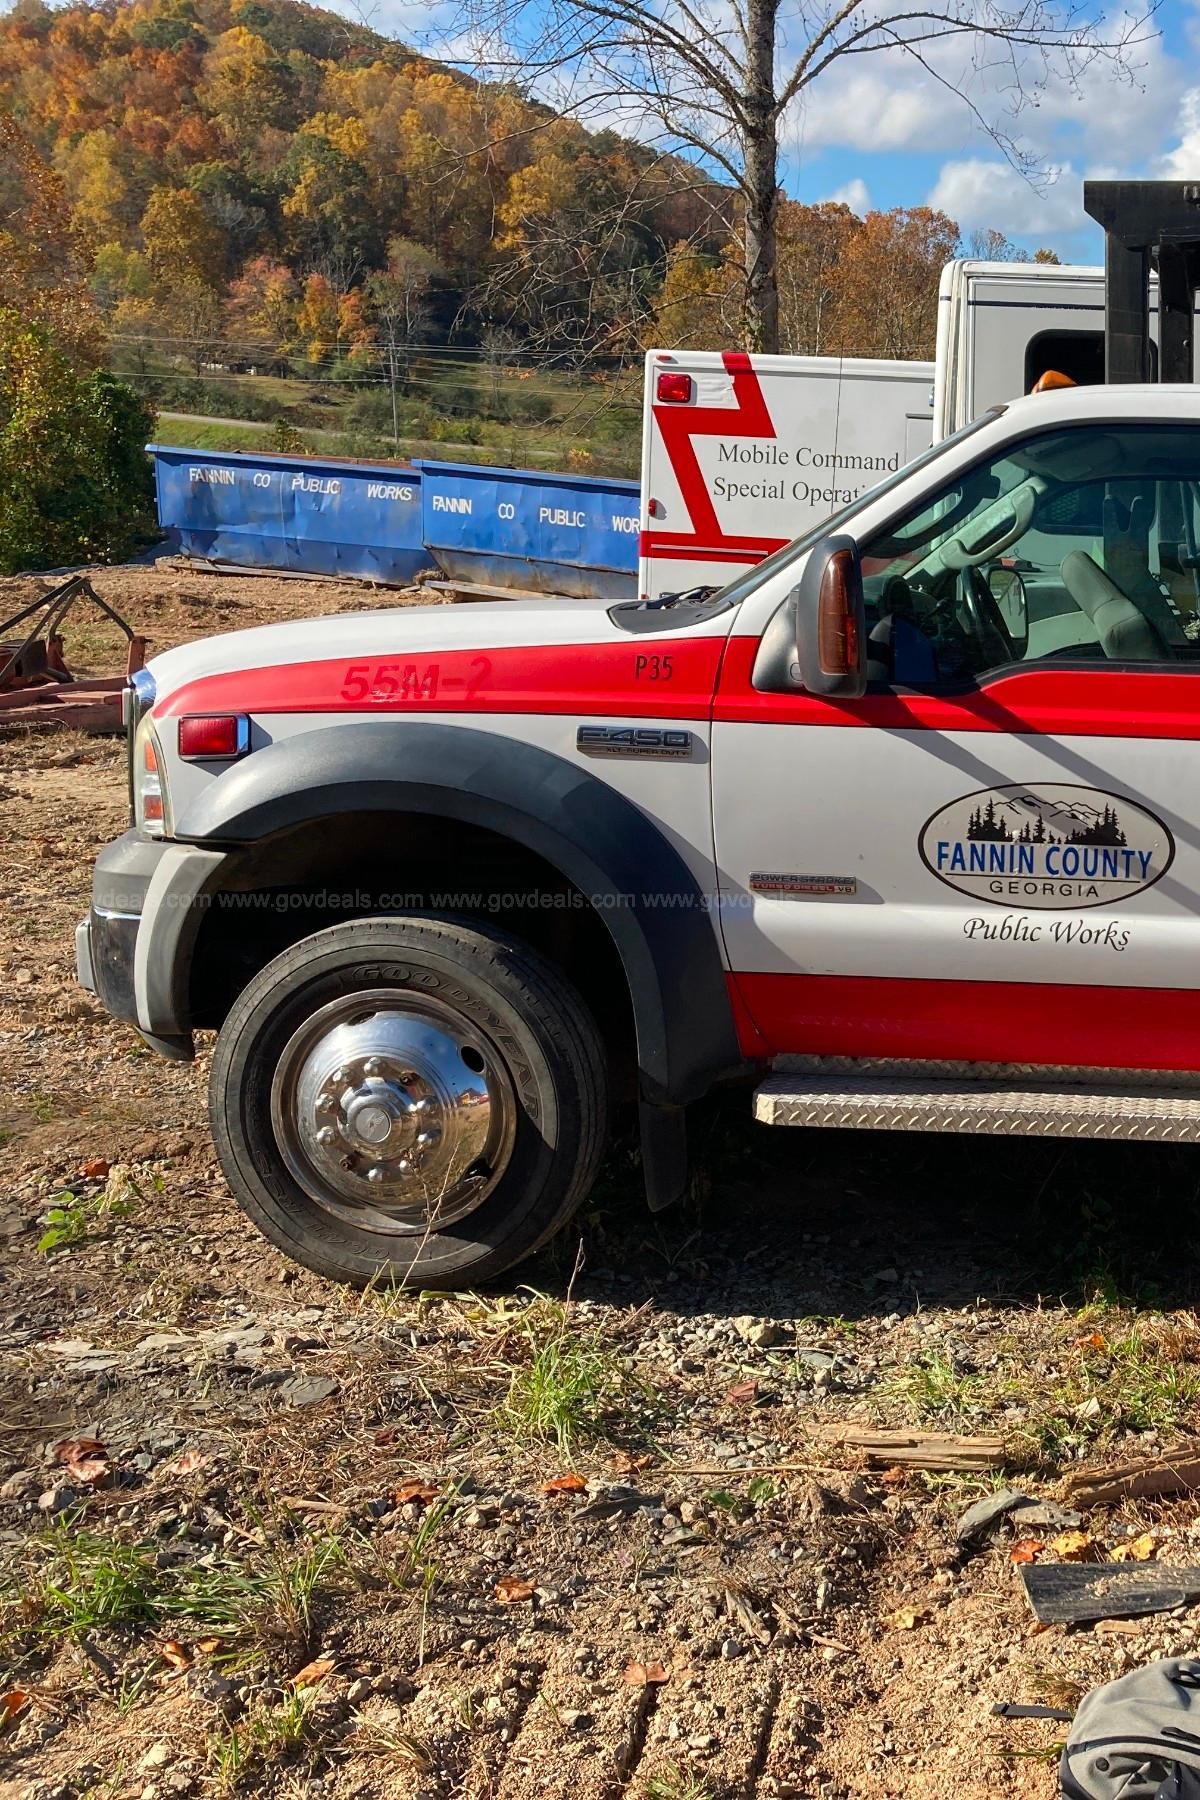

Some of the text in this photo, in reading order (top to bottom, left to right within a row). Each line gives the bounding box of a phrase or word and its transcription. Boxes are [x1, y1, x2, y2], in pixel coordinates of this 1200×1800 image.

[717, 443, 899, 472] Mobile Command
[189, 468, 412, 501] FANNIN CO PUBLIC WORKS
[713, 477, 868, 506] Special Operat
[432, 495, 641, 534] FANNIN CO PUBLIC WOR
[635, 655, 673, 681] P35
[937, 841, 1153, 880] FANNIN COUNTY
[989, 880, 1100, 898] GEORGIA
[963, 915, 1131, 952] Public Works
